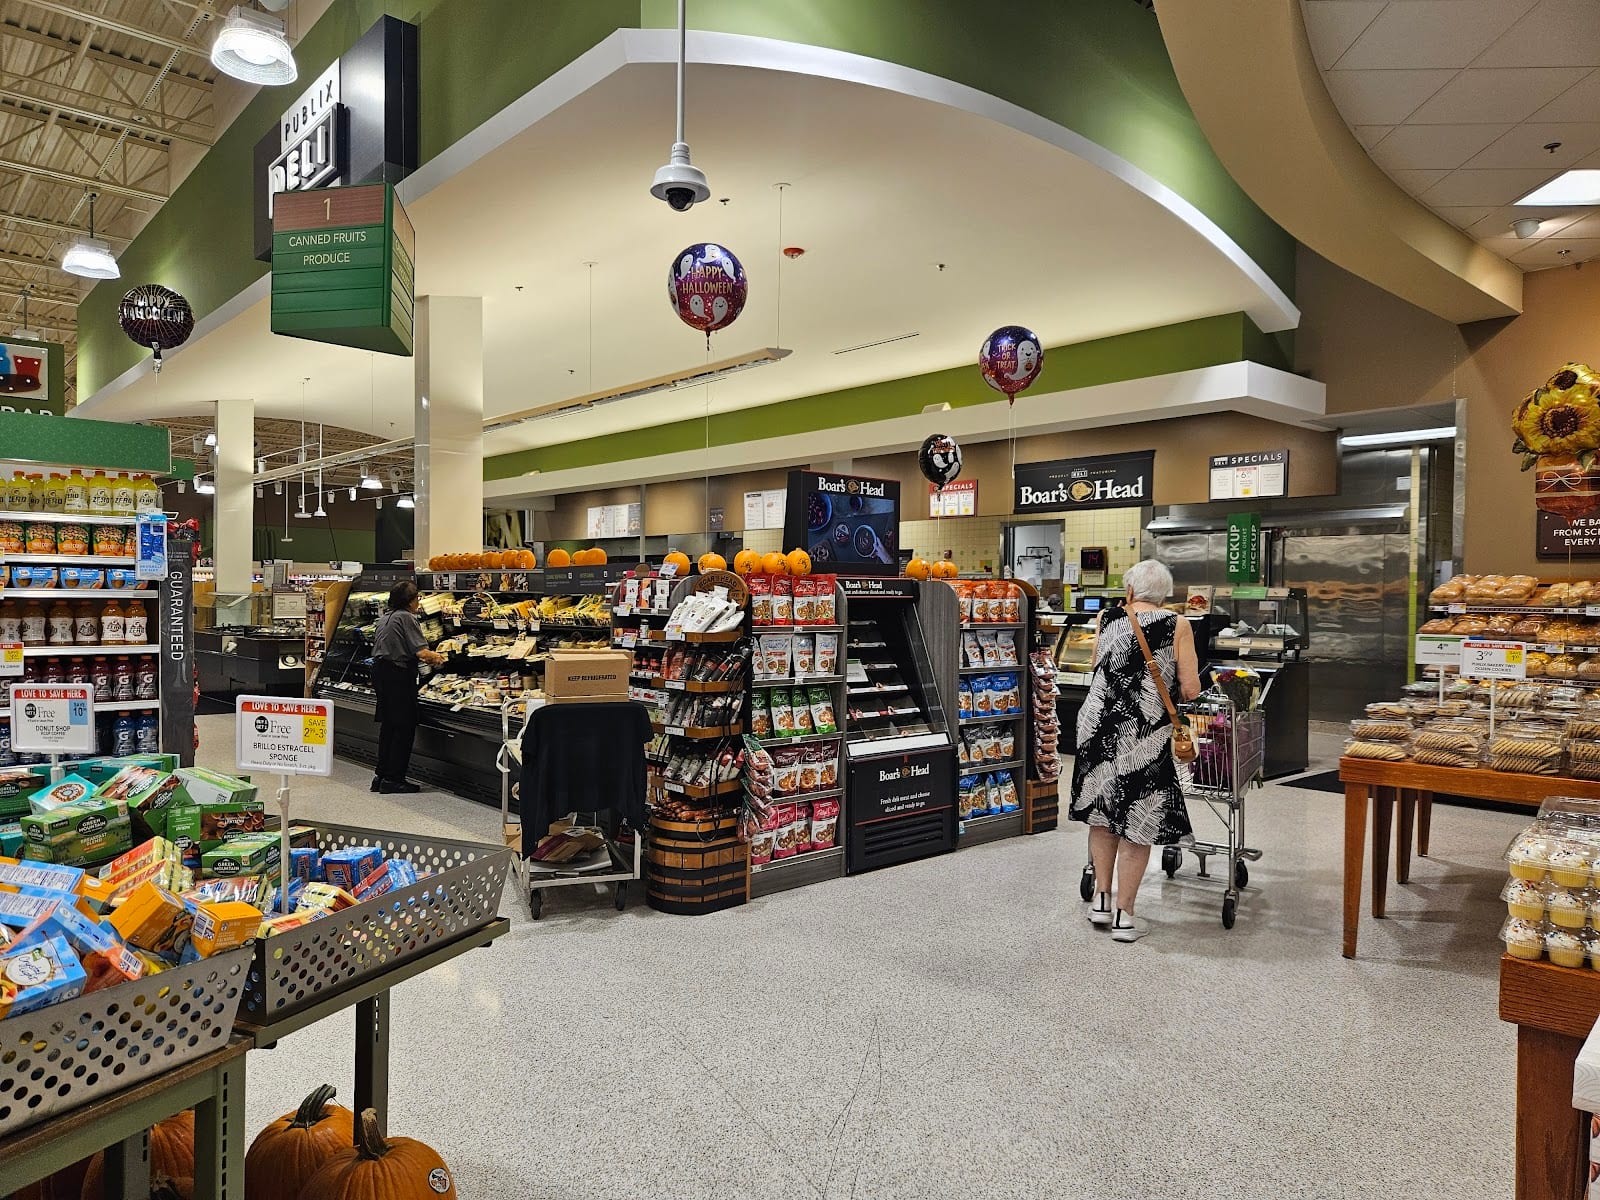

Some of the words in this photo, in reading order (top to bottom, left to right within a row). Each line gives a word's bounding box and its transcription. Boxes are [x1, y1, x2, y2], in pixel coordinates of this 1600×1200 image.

[285, 79, 333, 142] PUBLIX
[272, 125, 326, 192] DELI
[322, 197, 332, 221] 1
[288, 232, 331, 248] CANNED
[333, 230, 367, 245] FRUITS
[303, 252, 351, 267] PRODUCE
[691, 266, 723, 279] HAPPY
[682, 281, 733, 294] HALLOWEEN
[133, 294, 170, 308] HAPPY
[997, 343, 1016, 353] TRICK
[1001, 352, 1011, 360] OR
[996, 360, 1016, 369] TREAT
[1231, 453, 1282, 465] SPECIALS
[818, 476, 846, 493] Boar's
[860, 481, 884, 497] Head
[1020, 482, 1068, 505] Boar's
[1094, 475, 1144, 500] Head
[1553, 529, 1582, 537] FROM
[1564, 538, 1596, 546] EVERY
[1229, 524, 1240, 573] PICKUP
[868, 581, 883, 589] Head
[170, 571, 184, 661] GUARANTEED
[118, 675, 129, 685] G
[143, 673, 154, 683] G
[21, 689, 36, 698] LOVE
[39, 689, 47, 697] TO
[49, 689, 65, 698] SAVE
[37, 706, 56, 718] Free
[251, 702, 268, 710] LOVE
[271, 703, 280, 711] TO
[282, 704, 299, 712] SAVE
[301, 705, 320, 714] HERE.
[270, 720, 292, 734] Free
[308, 719, 326, 727] SAVE
[118, 731, 129, 741] G
[253, 742, 276, 751] BRILLO
[277, 744, 315, 753] ESTRACELL
[269, 753, 298, 762] SPONGE
[879, 767, 901, 781] Boar's
[910, 762, 930, 777] Head
[78, 820, 106, 833] MOUNTAIN
[82, 818, 101, 827] GREEN
